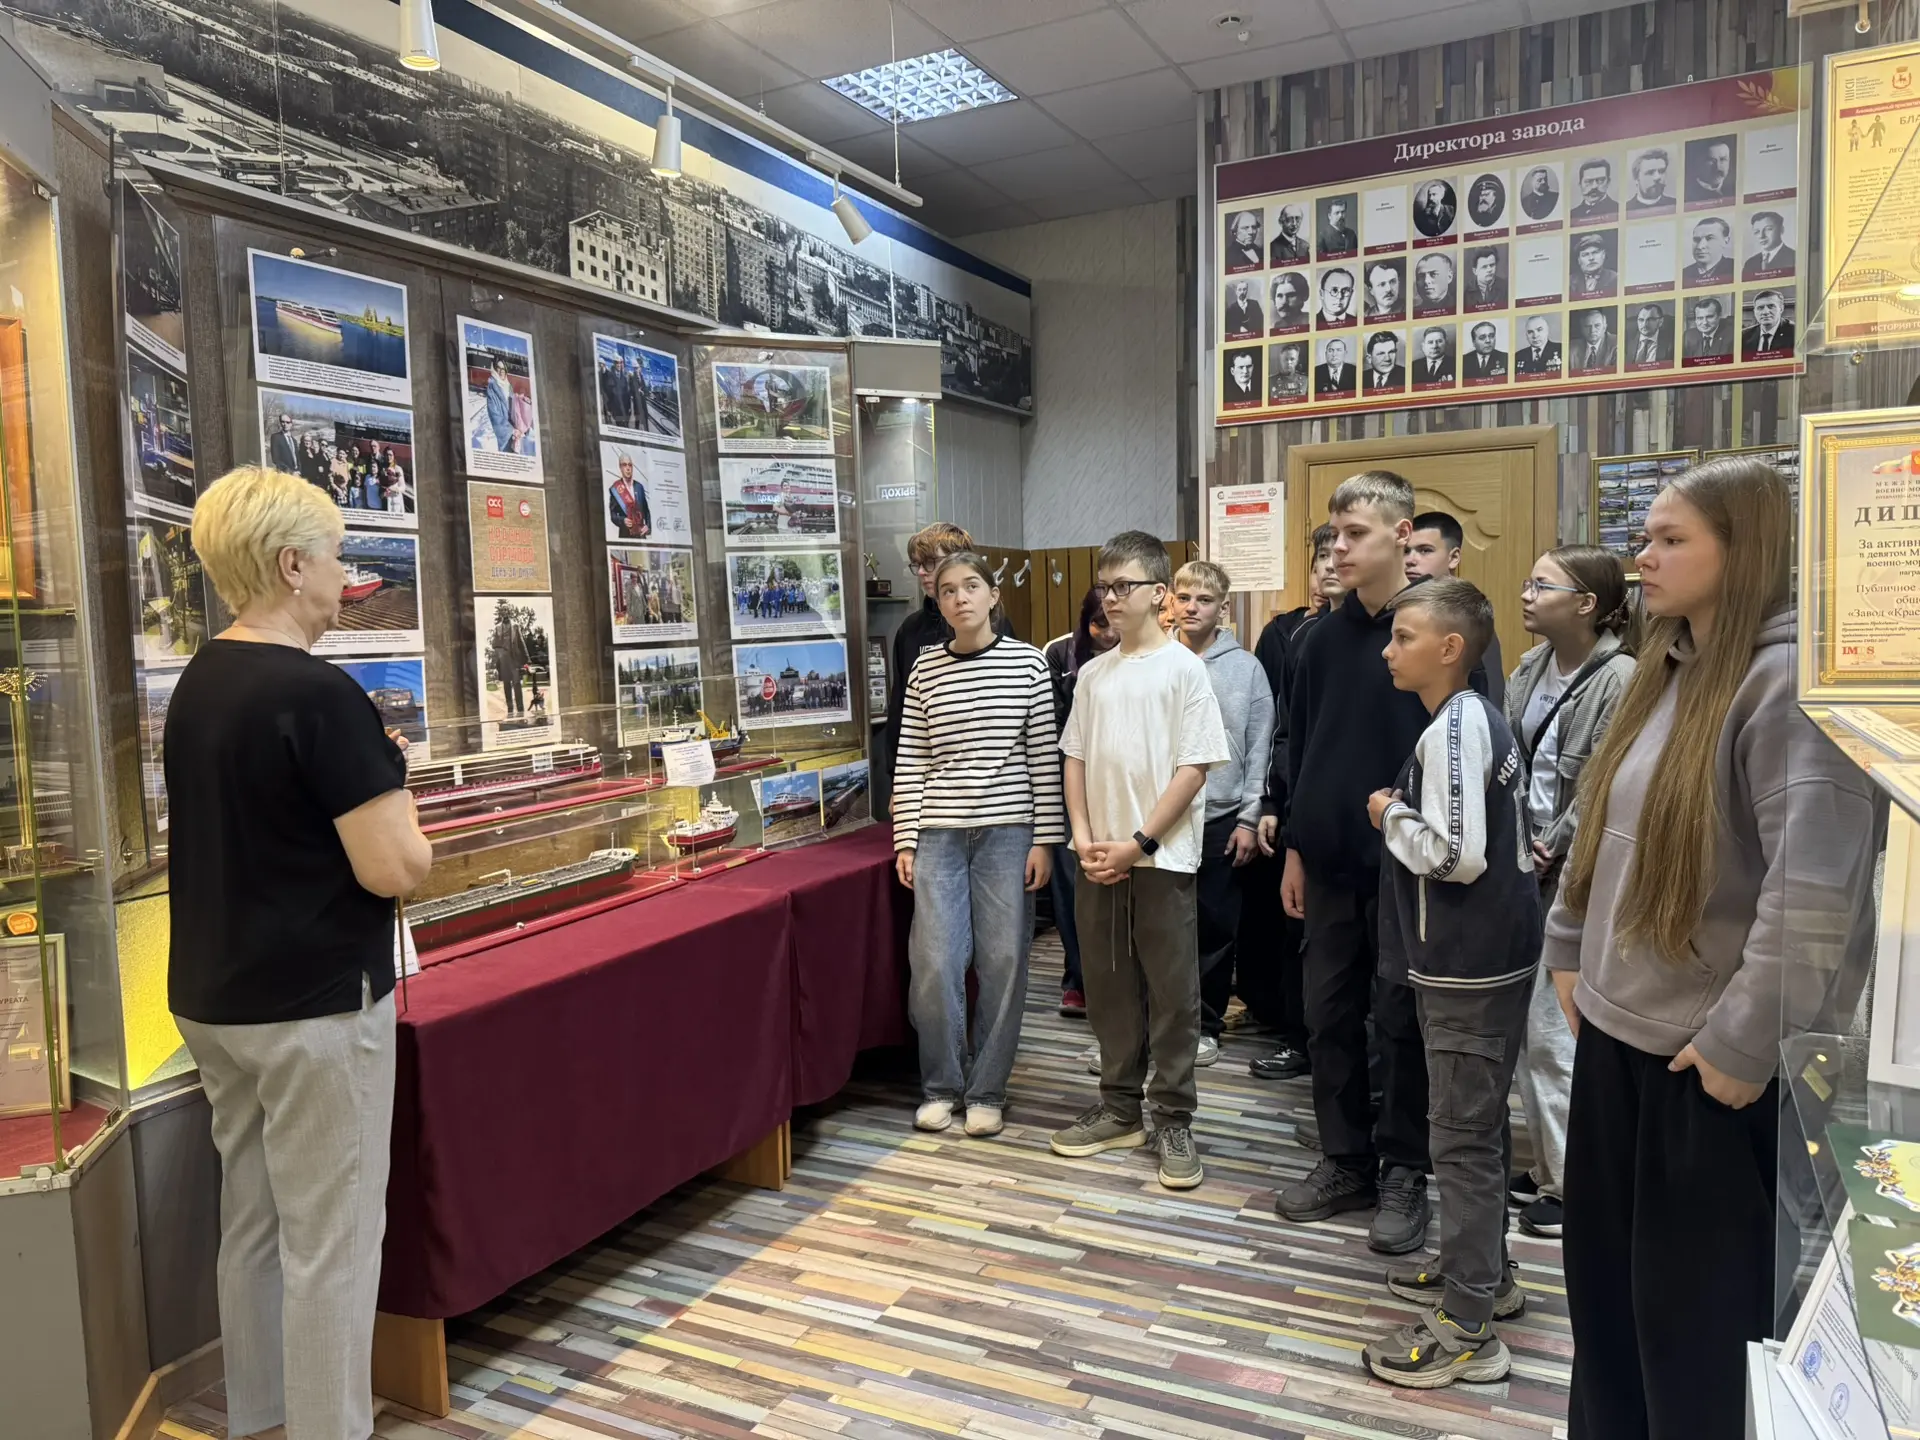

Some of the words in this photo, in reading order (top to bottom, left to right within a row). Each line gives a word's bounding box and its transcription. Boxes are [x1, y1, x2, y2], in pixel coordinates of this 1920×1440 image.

[1394, 130, 1505, 162] Директора
[1512, 117, 1585, 141] завода
[1871, 322, 1911, 332] ИСТОРИЯ
[1859, 539, 1873, 549] За
[1867, 551, 1906, 559] девятом
[1856, 583, 1916, 595] Публичное
[1848, 608, 1884, 617] «Завод
